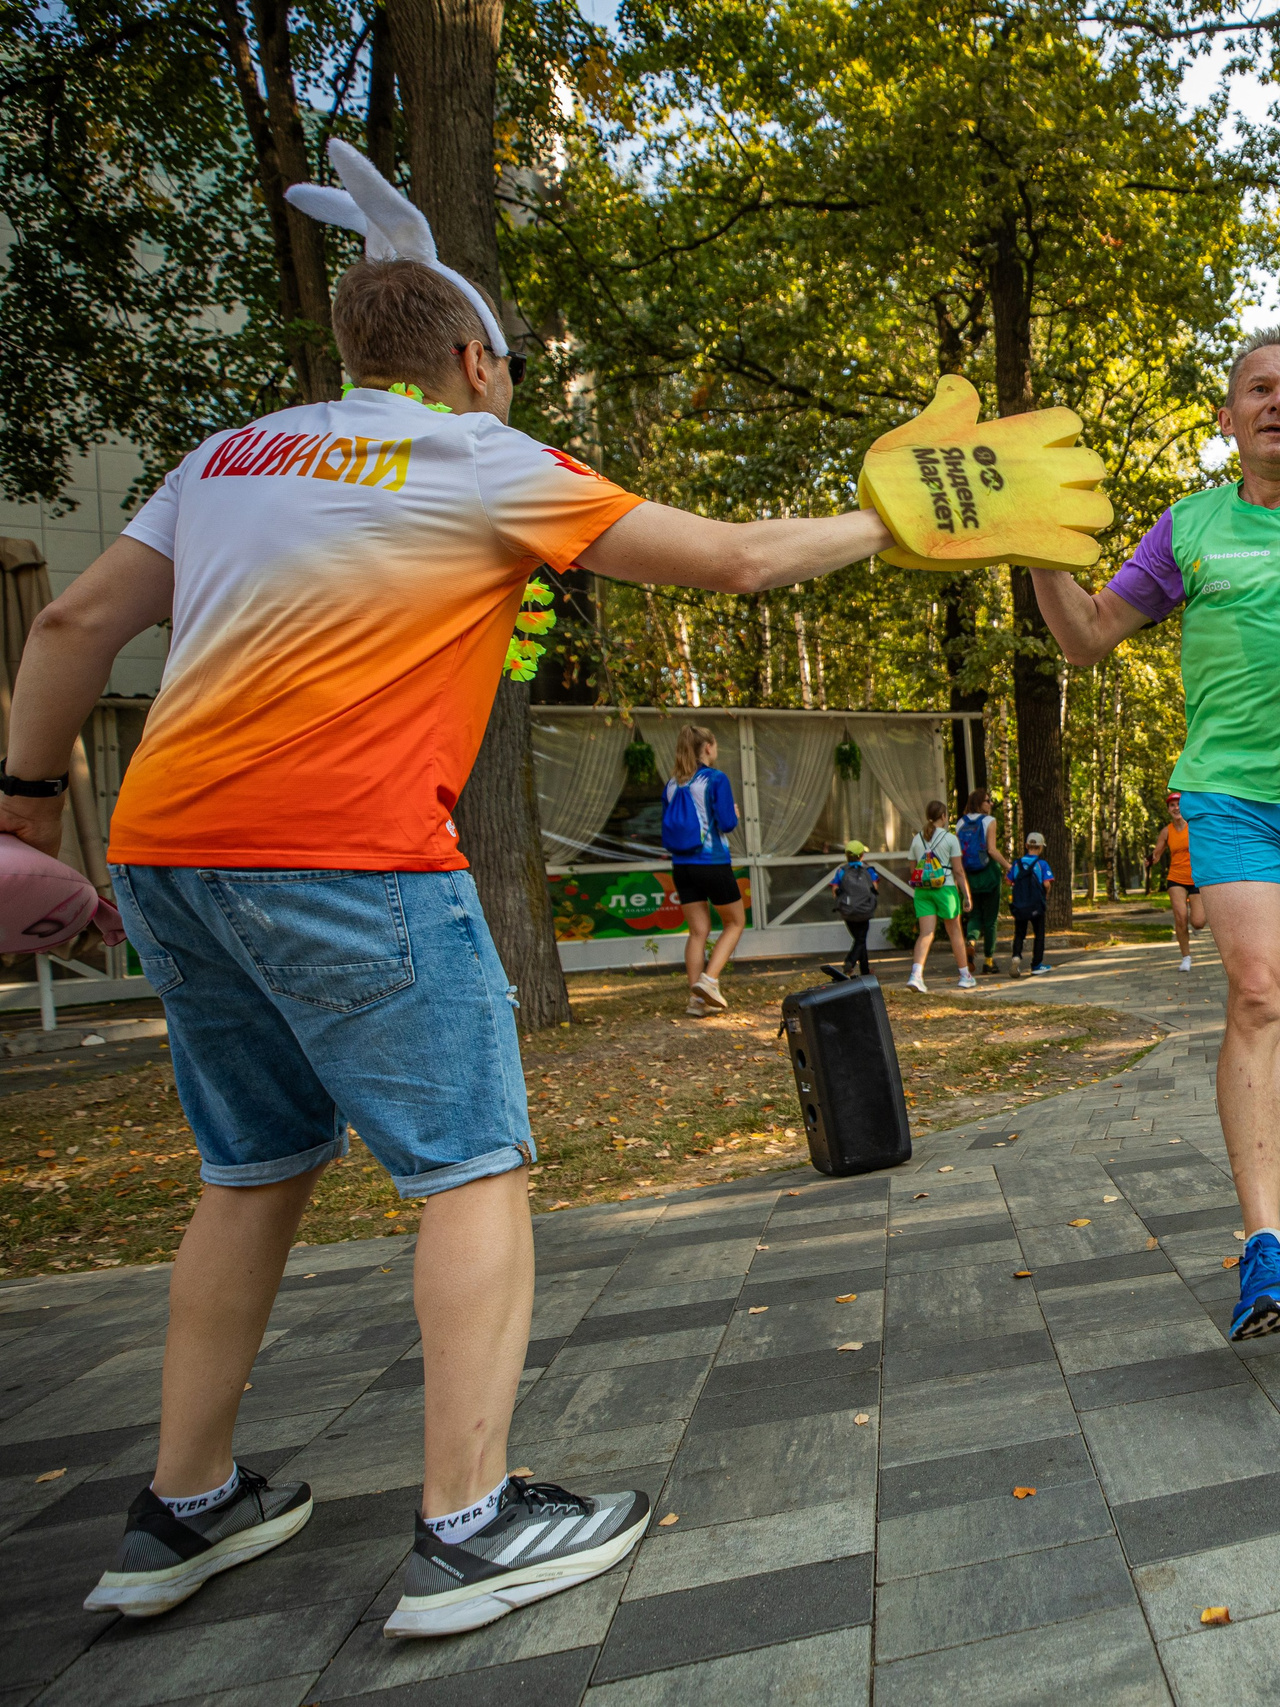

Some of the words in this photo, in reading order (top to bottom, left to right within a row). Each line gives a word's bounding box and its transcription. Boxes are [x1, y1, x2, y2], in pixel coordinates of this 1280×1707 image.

[912, 448, 955, 534] Маркет
[940, 447, 979, 529] Яндекс
[1203, 550, 1270, 561] ТИНЬКОФФ
[609, 891, 681, 908] лето
